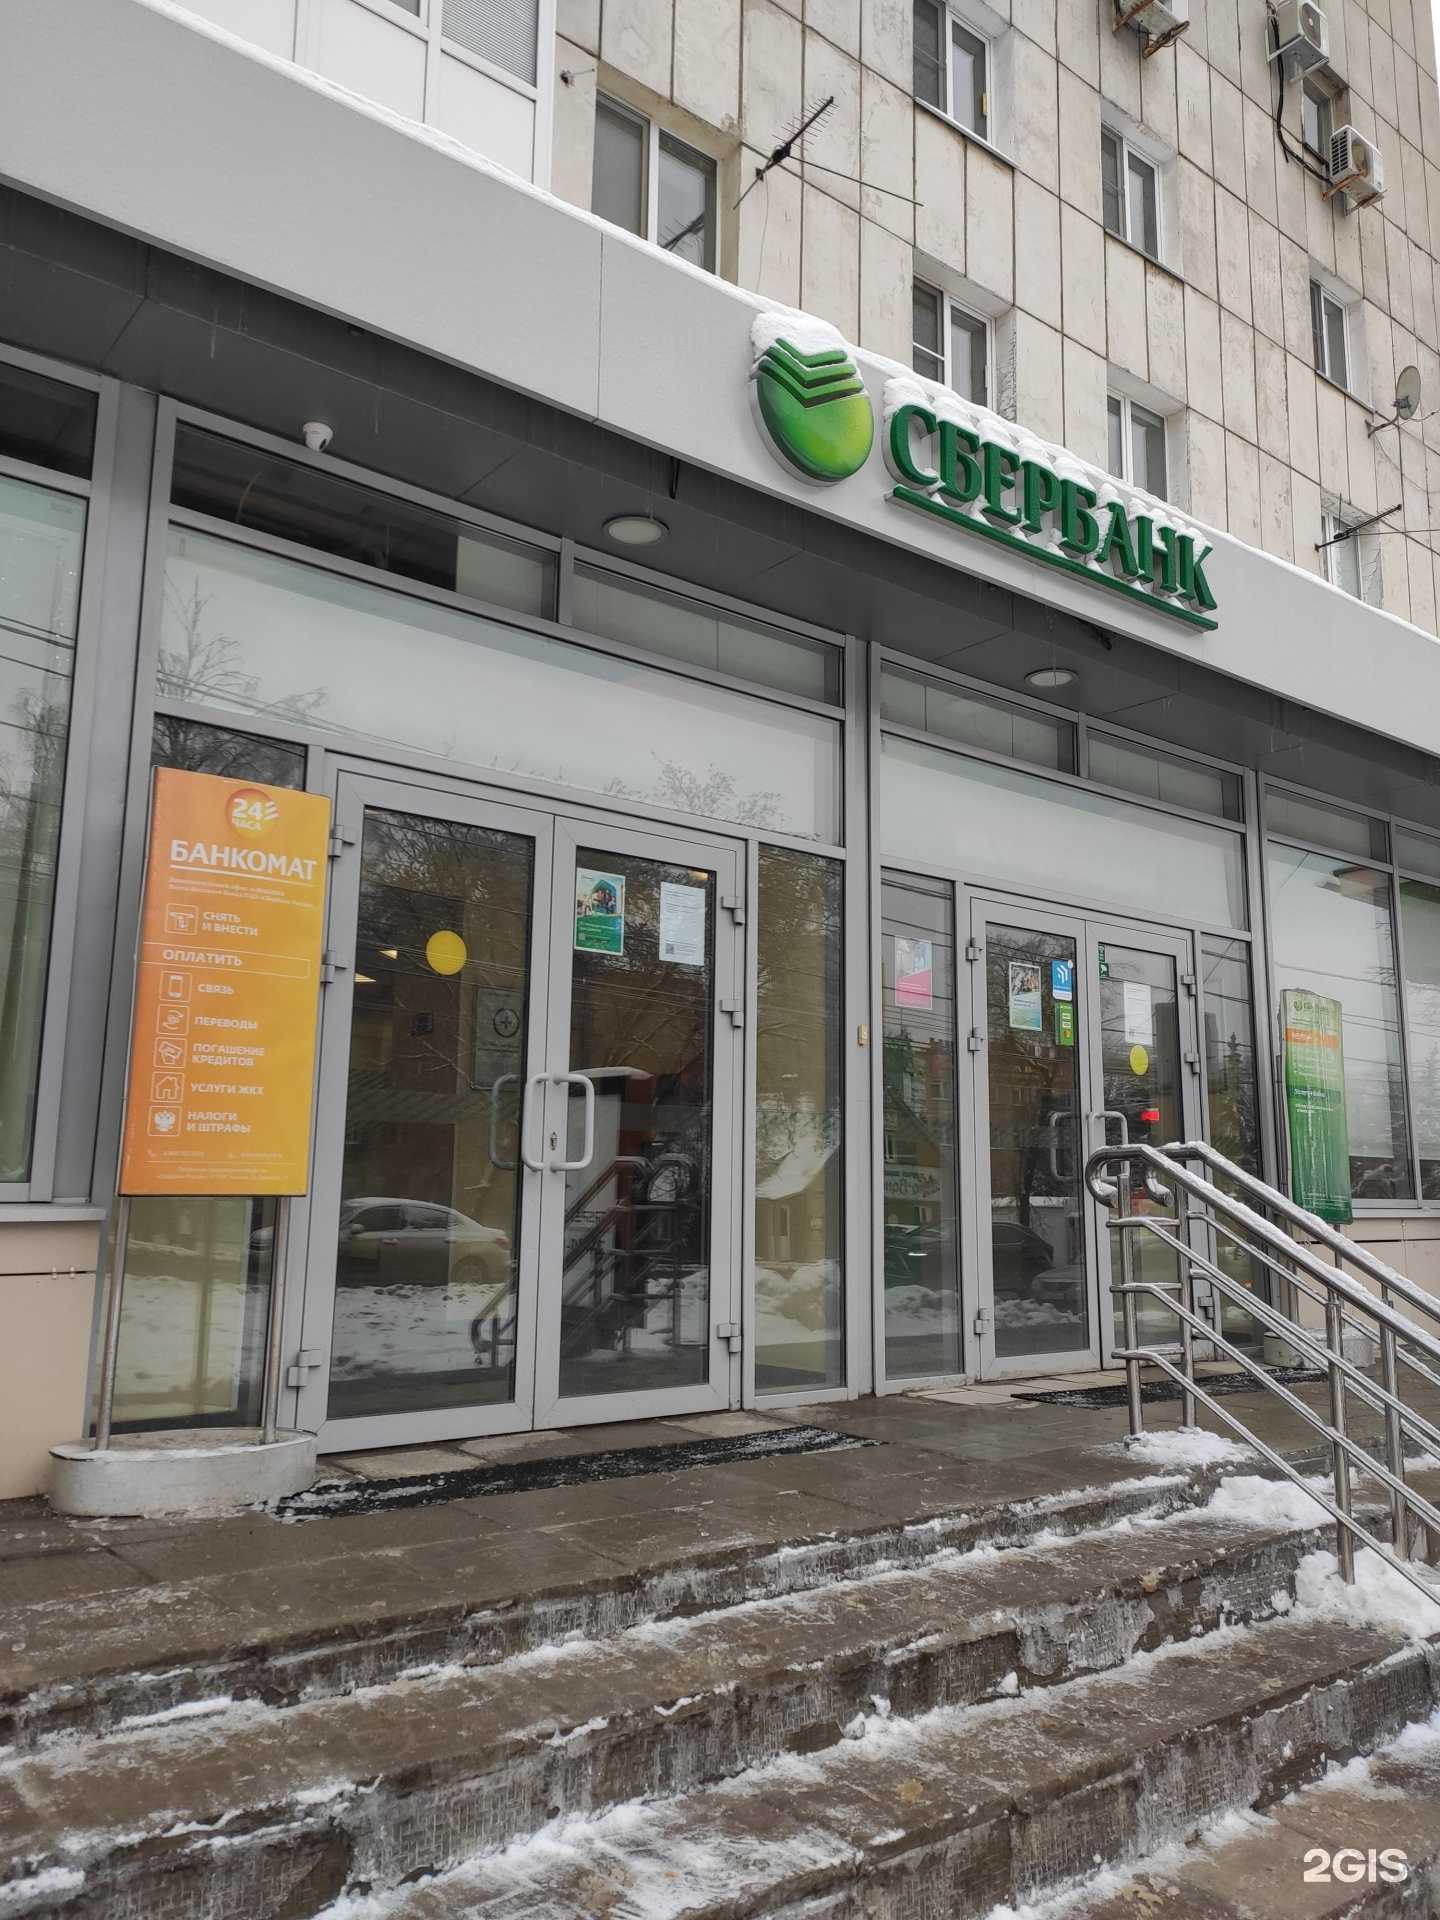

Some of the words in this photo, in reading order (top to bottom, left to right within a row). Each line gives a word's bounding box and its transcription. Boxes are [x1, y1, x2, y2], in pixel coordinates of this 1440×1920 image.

[889, 404, 1218, 612] СБЕРБАНК
[231, 797, 263, 820] 24
[169, 839, 317, 881] БАНКОМАТ
[203, 911, 241, 923] СНЯТЬ
[202, 921, 212, 932] И
[214, 923, 258, 936] ВНЕСТИ
[163, 949, 243, 967] ОПЛАТИТЬ
[198, 984, 234, 995] СВЯЗЬ
[194, 1016, 257, 1031] ПЕРЕВОДЫ
[192, 1042, 265, 1057] ПОГАШЕНИЕ
[191, 1054, 255, 1068] КРЕДИТОВ
[191, 1082, 236, 1095] УСЛУГИ
[238, 1085, 265, 1096] ЖКХ
[187, 1111, 238, 1122] НАЛОГИ
[186, 1122, 196, 1133] И
[198, 1122, 252, 1134] ШТРАФЫ
